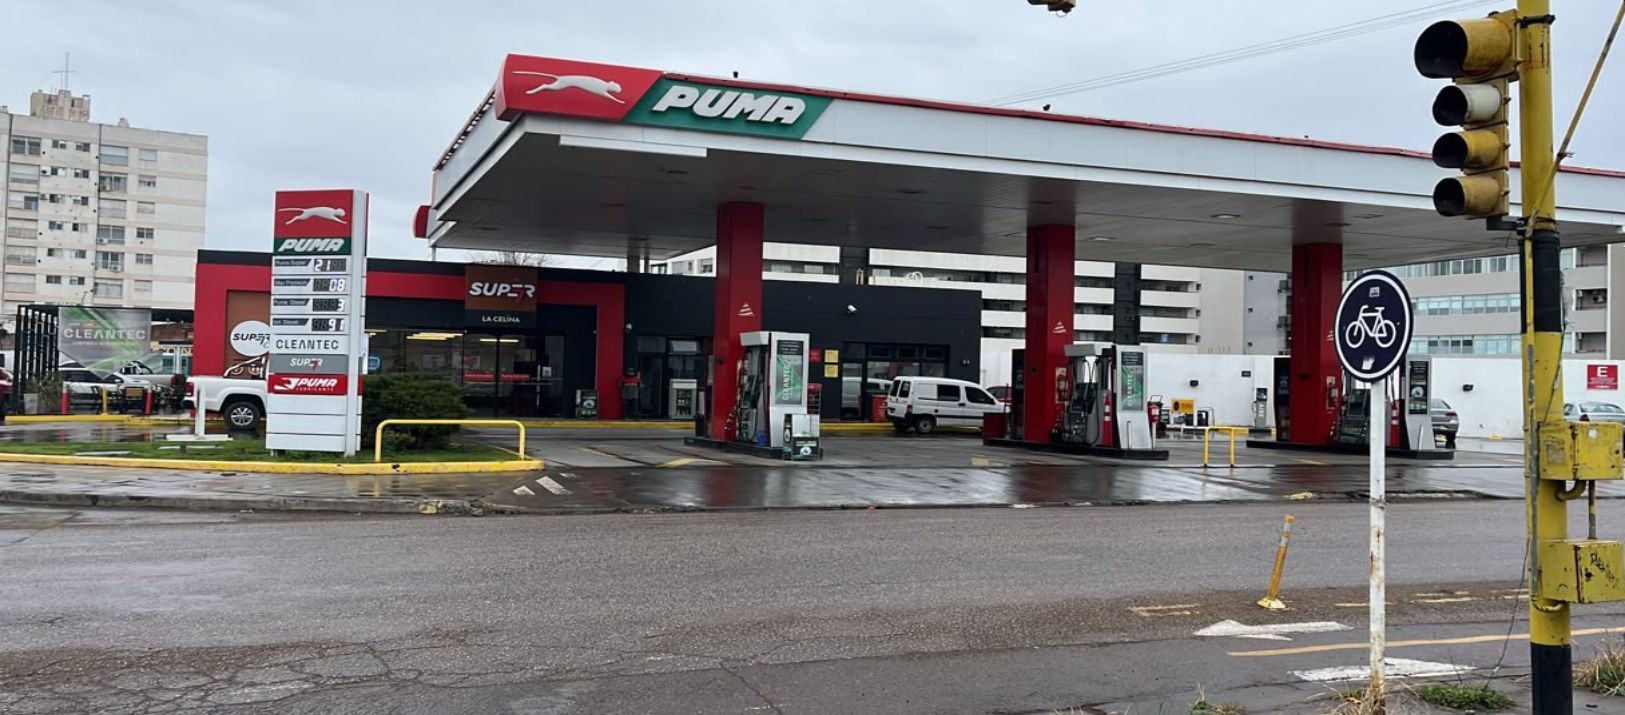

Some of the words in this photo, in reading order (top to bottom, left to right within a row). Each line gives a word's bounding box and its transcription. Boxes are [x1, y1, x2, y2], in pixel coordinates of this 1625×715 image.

[652, 85, 806, 125] PUMA
[278, 238, 345, 252] PUMA
[63, 328, 146, 340] CLEANTEC
[275, 339, 339, 350] CLEANTEC
[1597, 366, 1608, 377] E
[297, 378, 338, 387] PUMA
